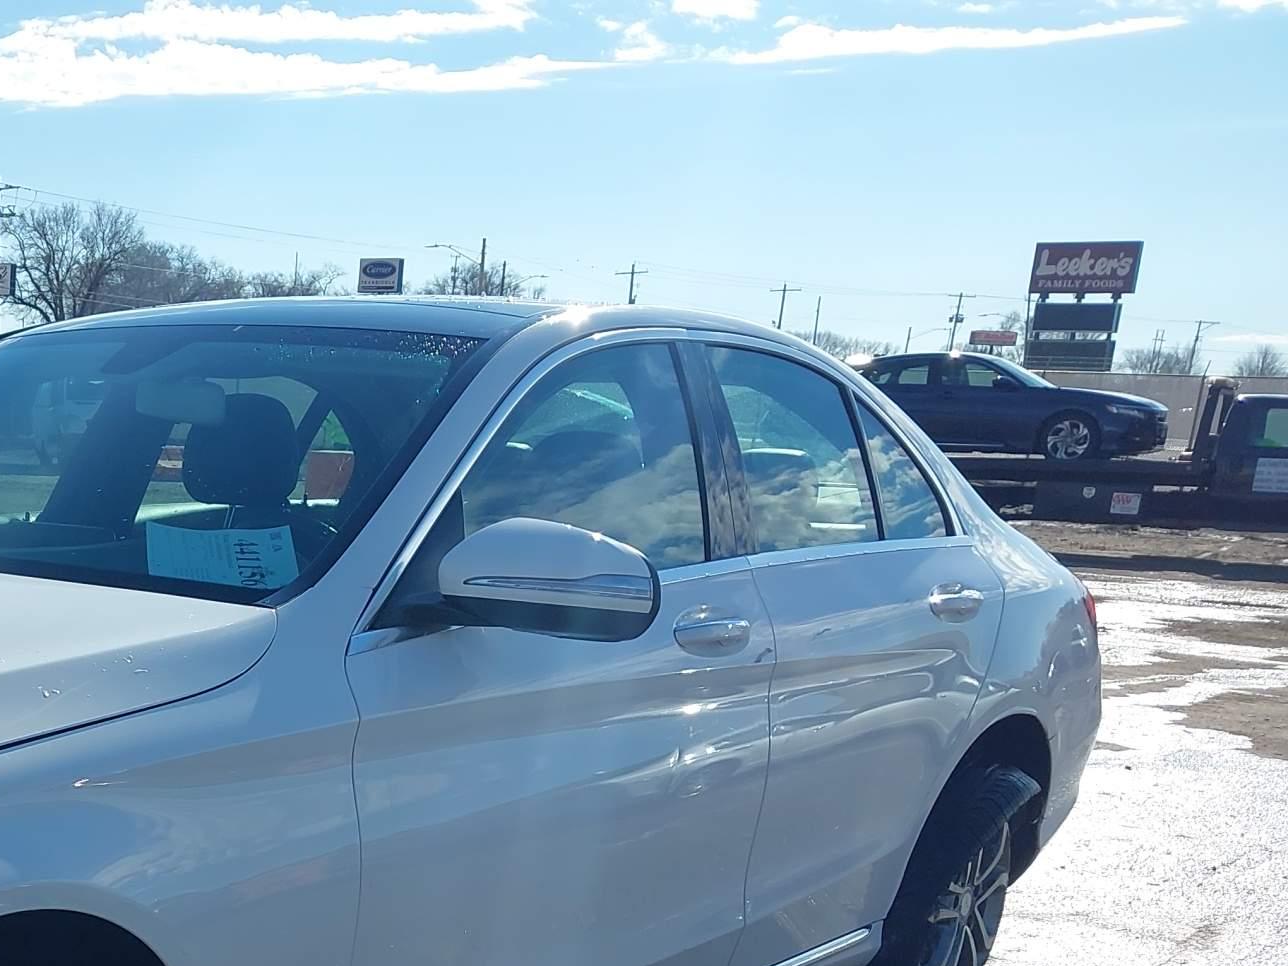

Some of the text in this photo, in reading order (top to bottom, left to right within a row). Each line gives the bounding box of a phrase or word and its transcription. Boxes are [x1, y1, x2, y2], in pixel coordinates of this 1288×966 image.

[1035, 248, 1133, 277] Leeker's
[1038, 279, 1124, 289] FAMILY FOODS
